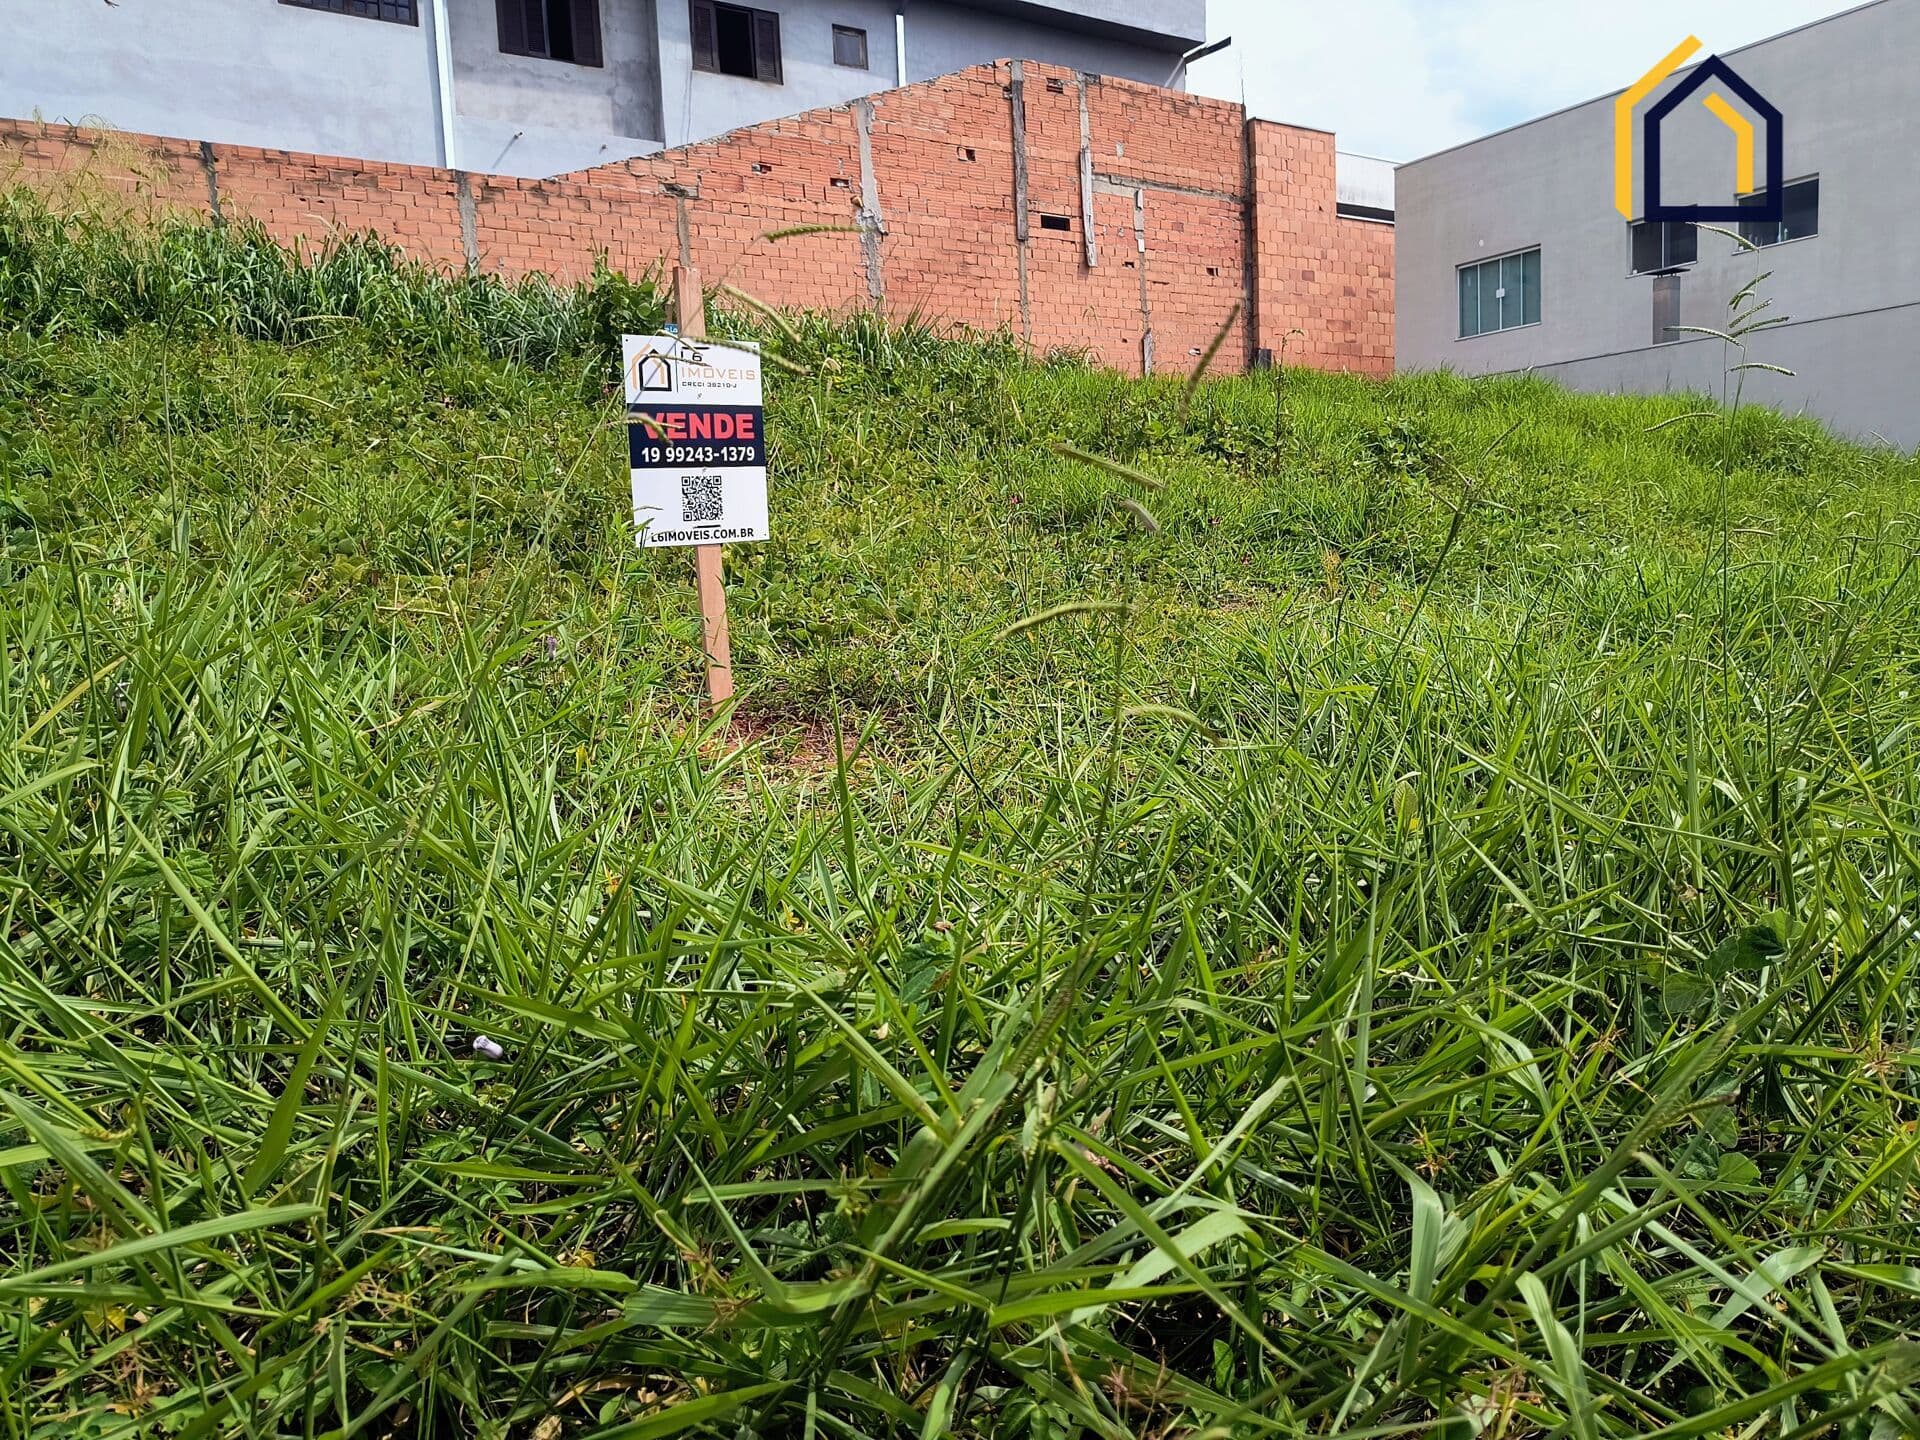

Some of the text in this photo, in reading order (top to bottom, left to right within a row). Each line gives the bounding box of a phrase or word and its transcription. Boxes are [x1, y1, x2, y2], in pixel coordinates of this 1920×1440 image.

[641, 412, 755, 439] VENDE
[641, 446, 755, 462] 19 99243-1379
[651, 527, 754, 542] L6IMOVEIS.COM.BR
